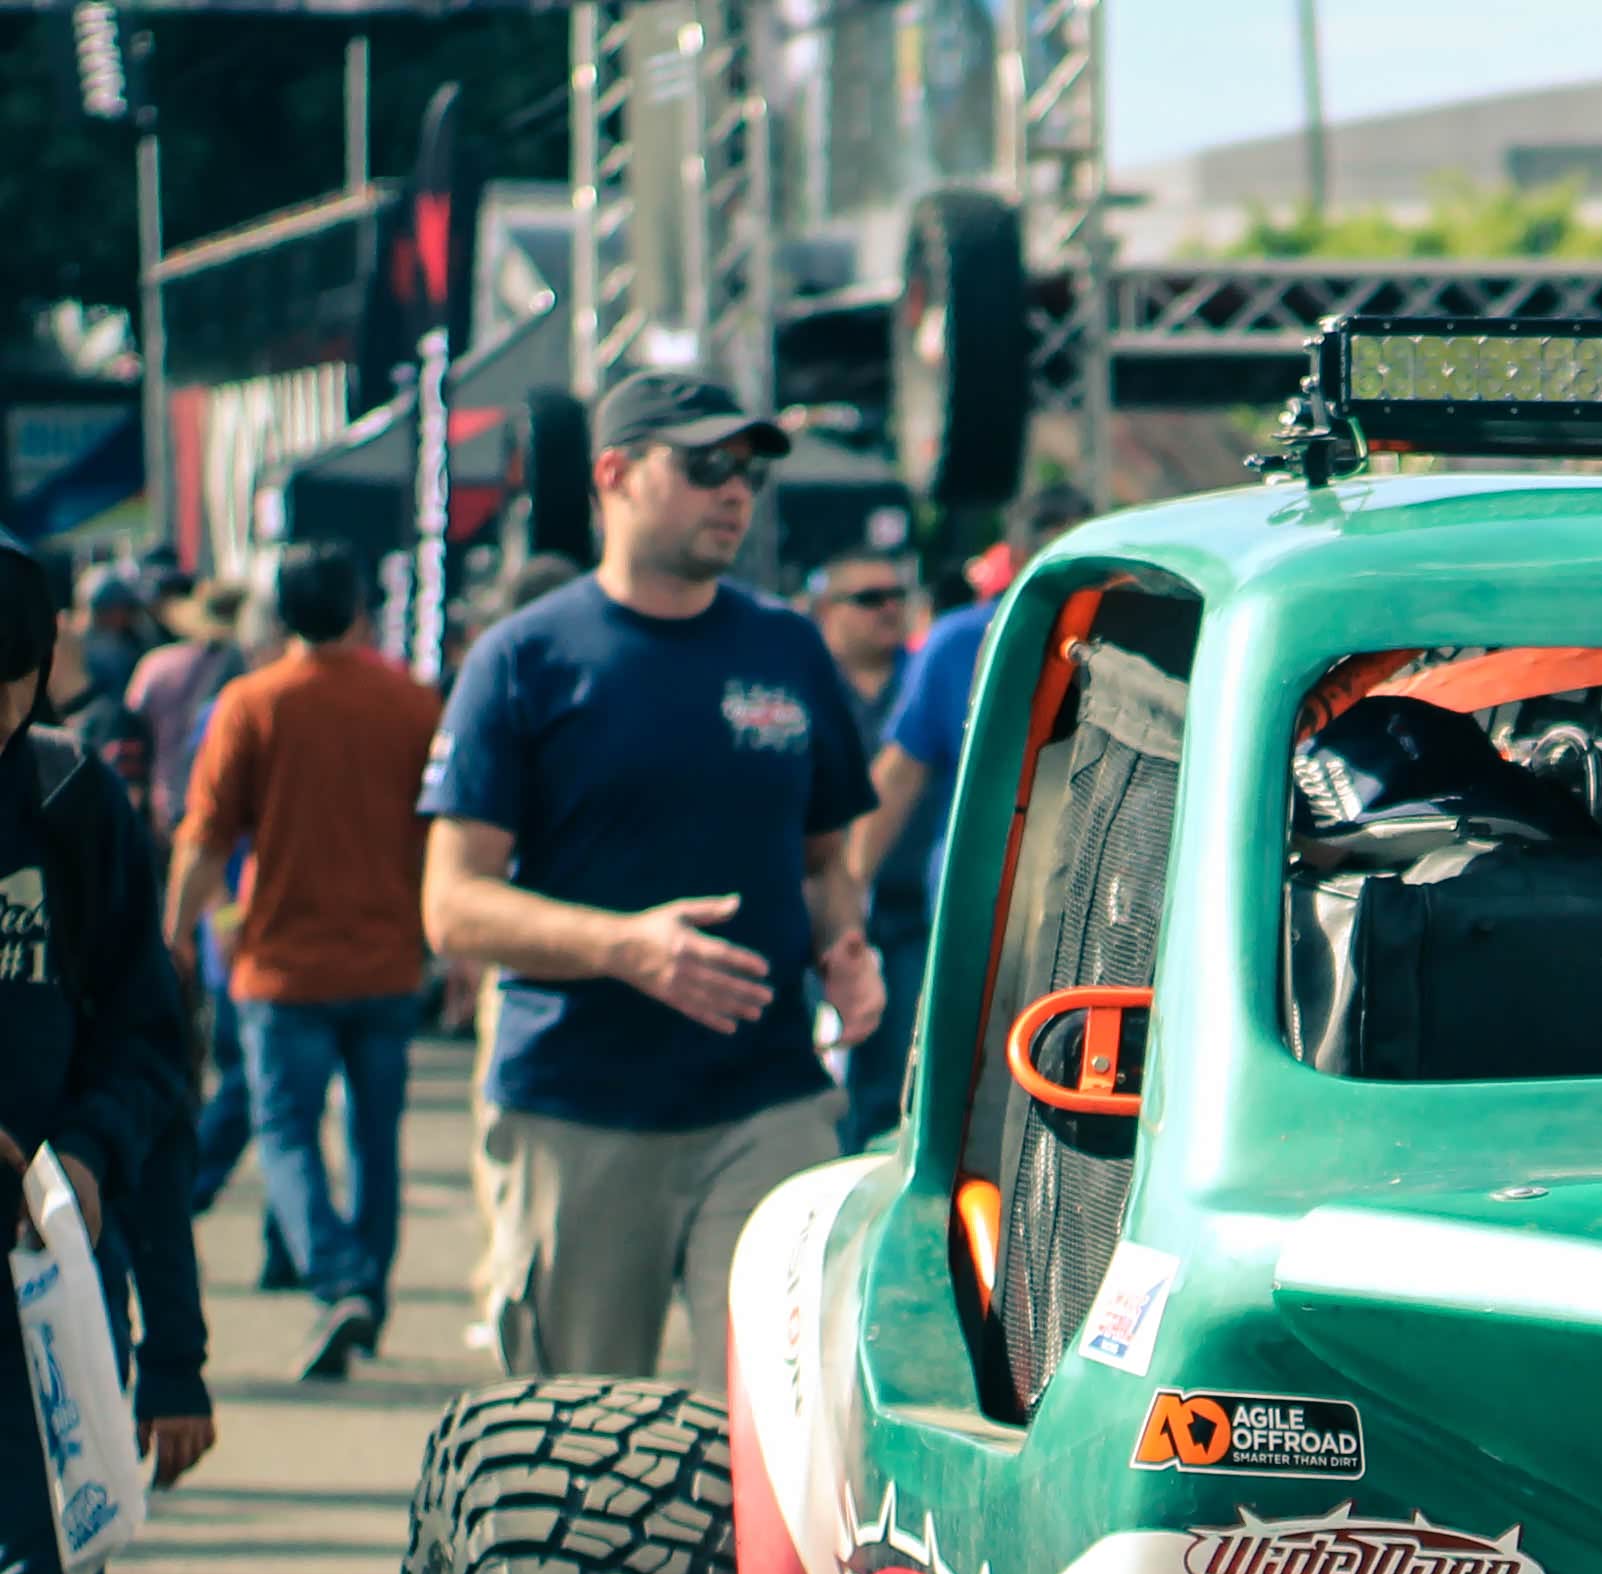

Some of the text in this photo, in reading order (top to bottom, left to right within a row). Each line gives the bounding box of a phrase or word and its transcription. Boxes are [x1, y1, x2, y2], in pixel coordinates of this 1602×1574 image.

[1232, 1406, 1305, 1431] AGILE
[1232, 1428, 1358, 1455] OFFROAD
[1232, 1452, 1359, 1468] SMARTER THAN DIRT
